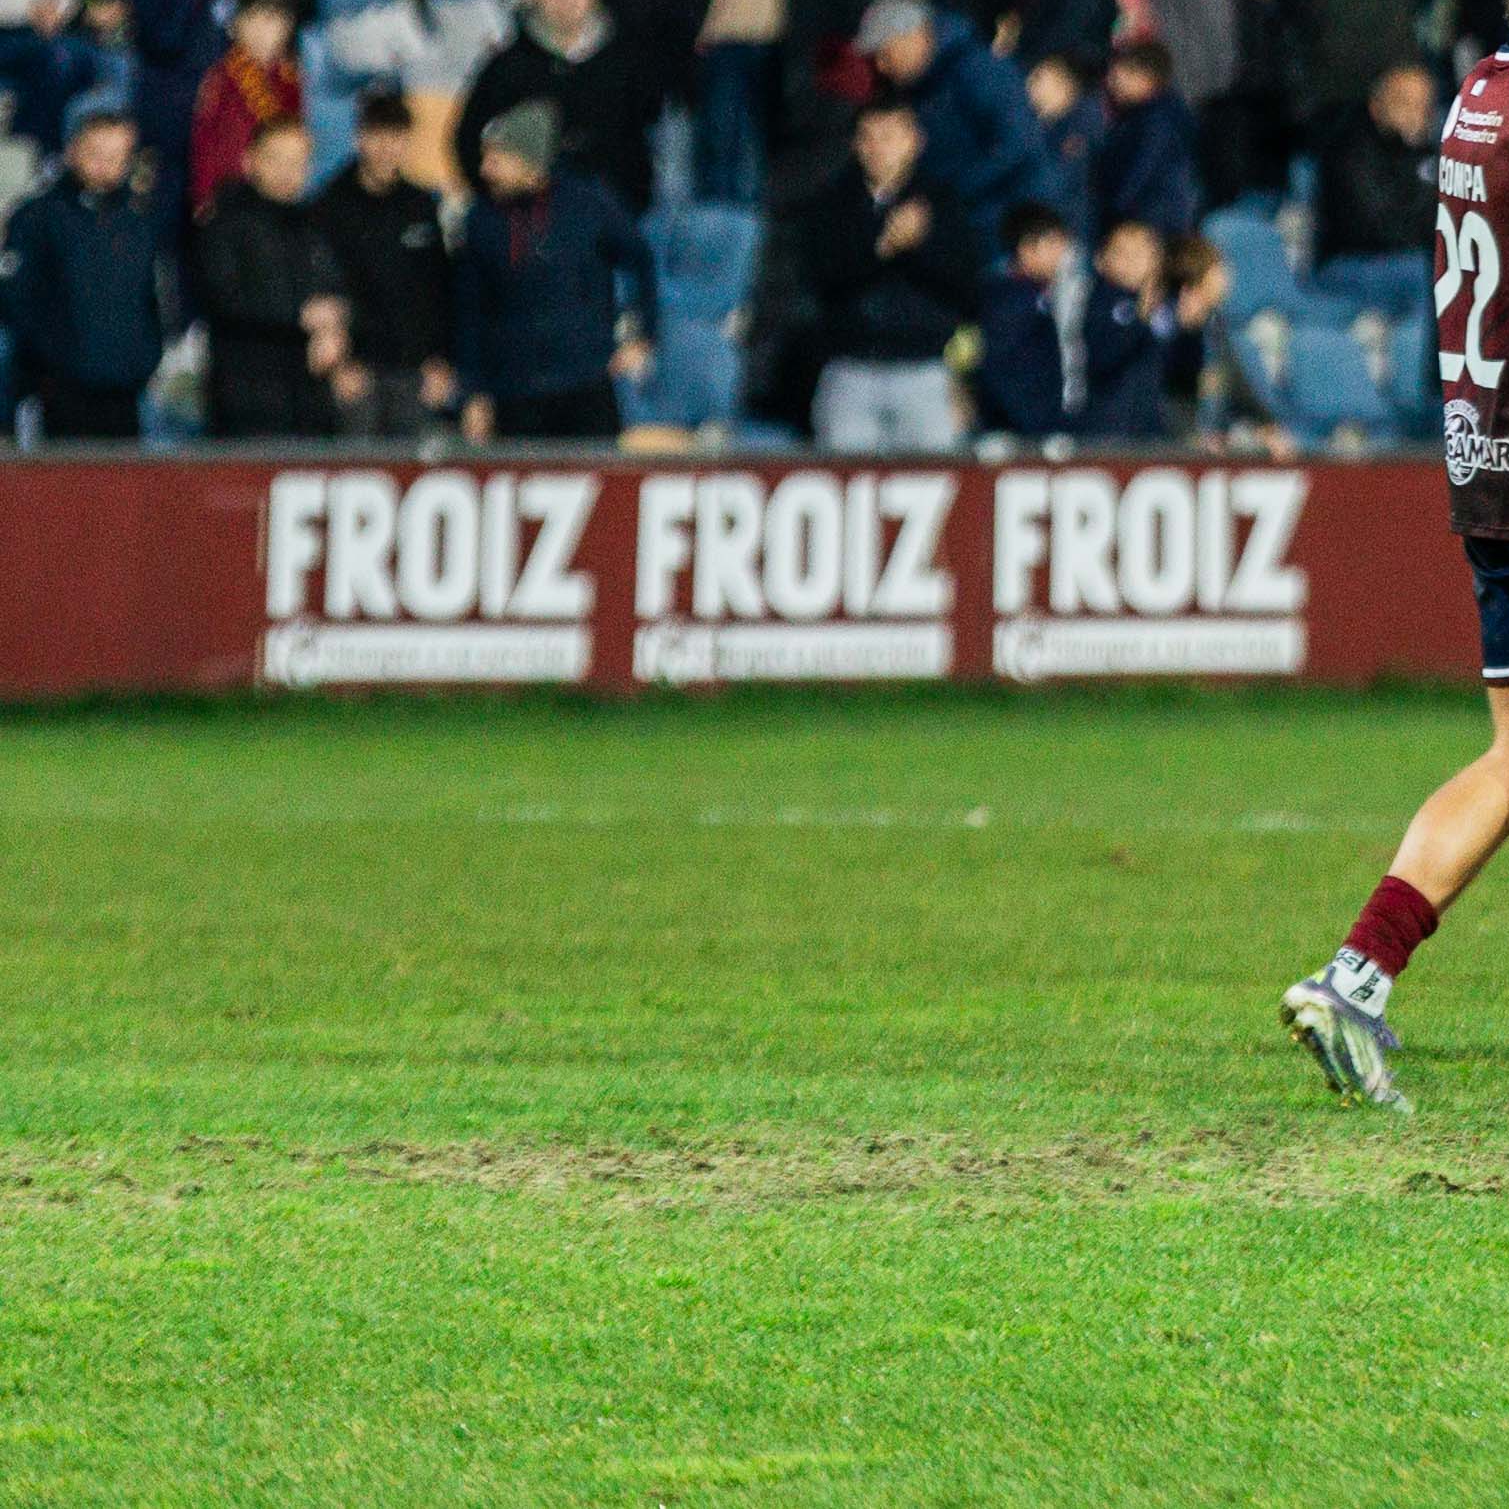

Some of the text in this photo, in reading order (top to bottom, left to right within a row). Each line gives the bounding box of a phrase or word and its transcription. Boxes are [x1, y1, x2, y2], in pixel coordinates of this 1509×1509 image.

[265, 469, 600, 620] FROIZ
[633, 469, 960, 620] FROIZ
[992, 467, 1312, 614] FROIZ
